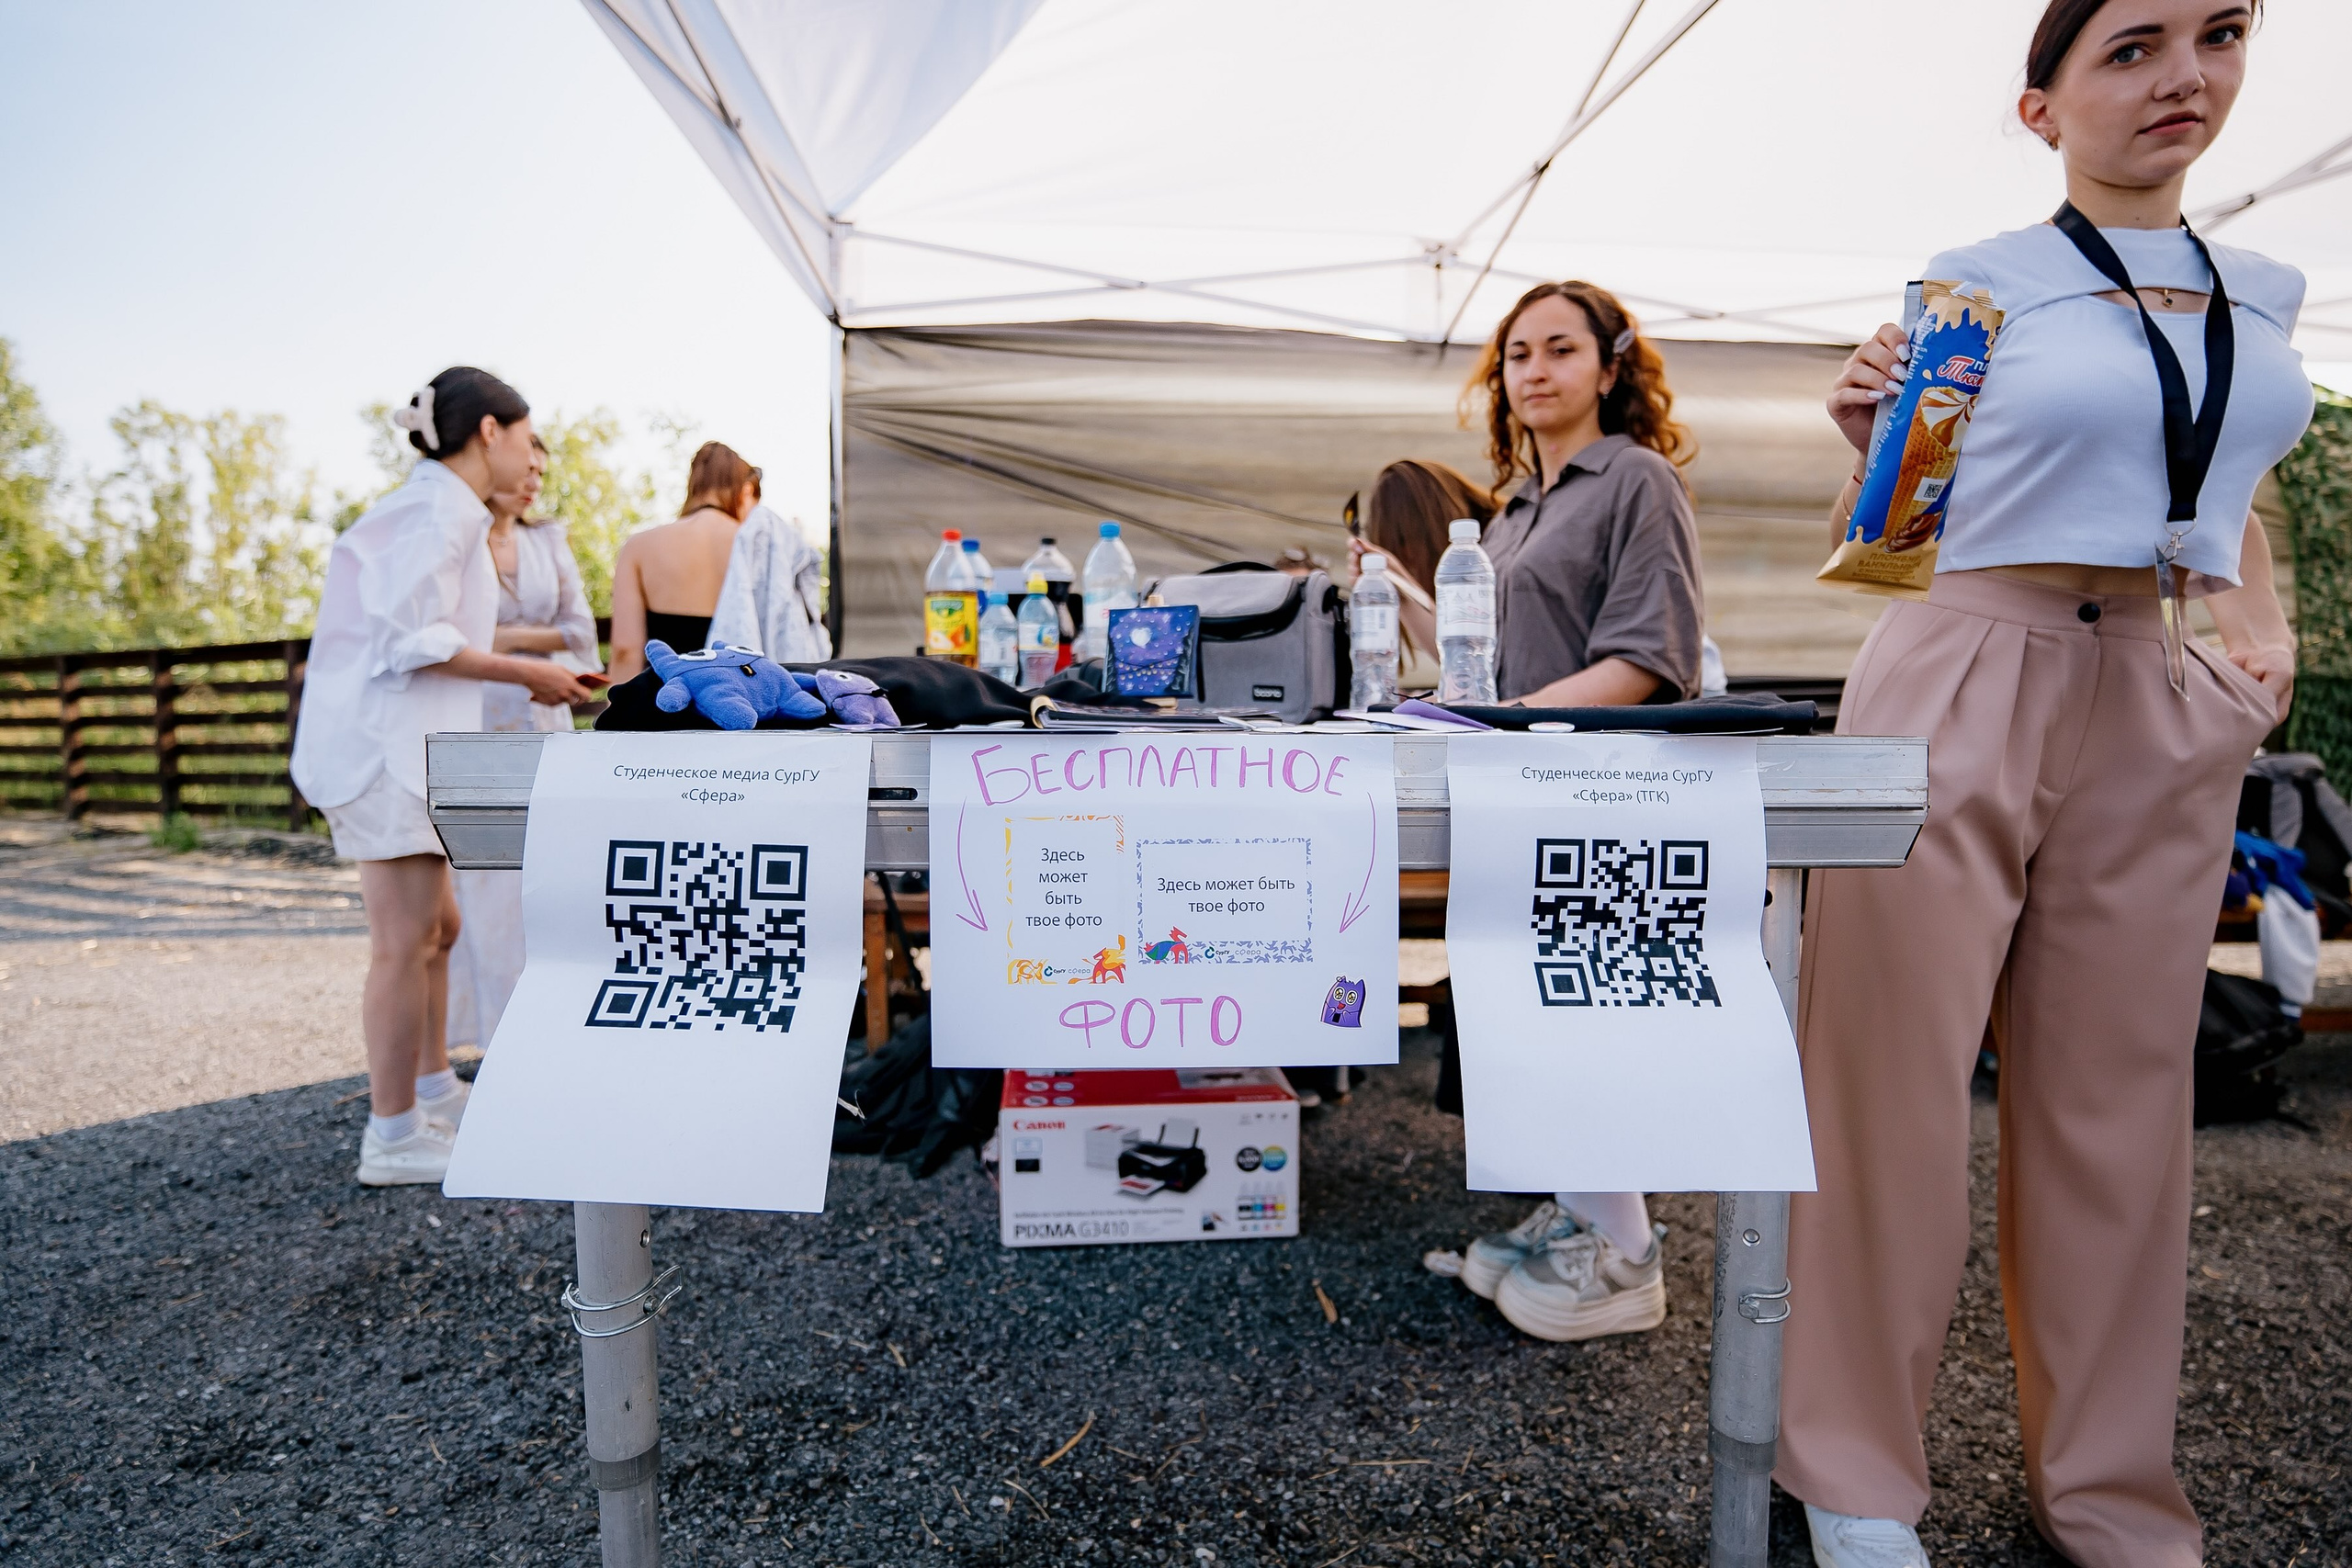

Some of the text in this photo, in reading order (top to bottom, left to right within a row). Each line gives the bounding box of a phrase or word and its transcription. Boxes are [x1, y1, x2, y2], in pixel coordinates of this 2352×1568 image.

[614, 764, 820, 785] Студенческое медиа СурГУ
[970, 744, 1350, 806] БЕСПЛАТНОЕ
[1521, 766, 1713, 784] Студенческое медиа СурГУ
[681, 787, 745, 806] «Сфера»
[1572, 788, 1669, 806] «Сфера» (ТГК)
[1041, 847, 1085, 863] Здесь
[1038, 871, 1089, 884] может
[1157, 875, 1295, 893] Здесь может быть
[1045, 890, 1082, 905] быть
[1188, 897, 1265, 915] твое фото
[1025, 912, 1102, 930] твое фото
[1059, 996, 1243, 1049] ФОТО
[1012, 1119, 1066, 1131] Canon
[1014, 1221, 1077, 1239] PIXMA
[1078, 1220, 1131, 1237] G3410
